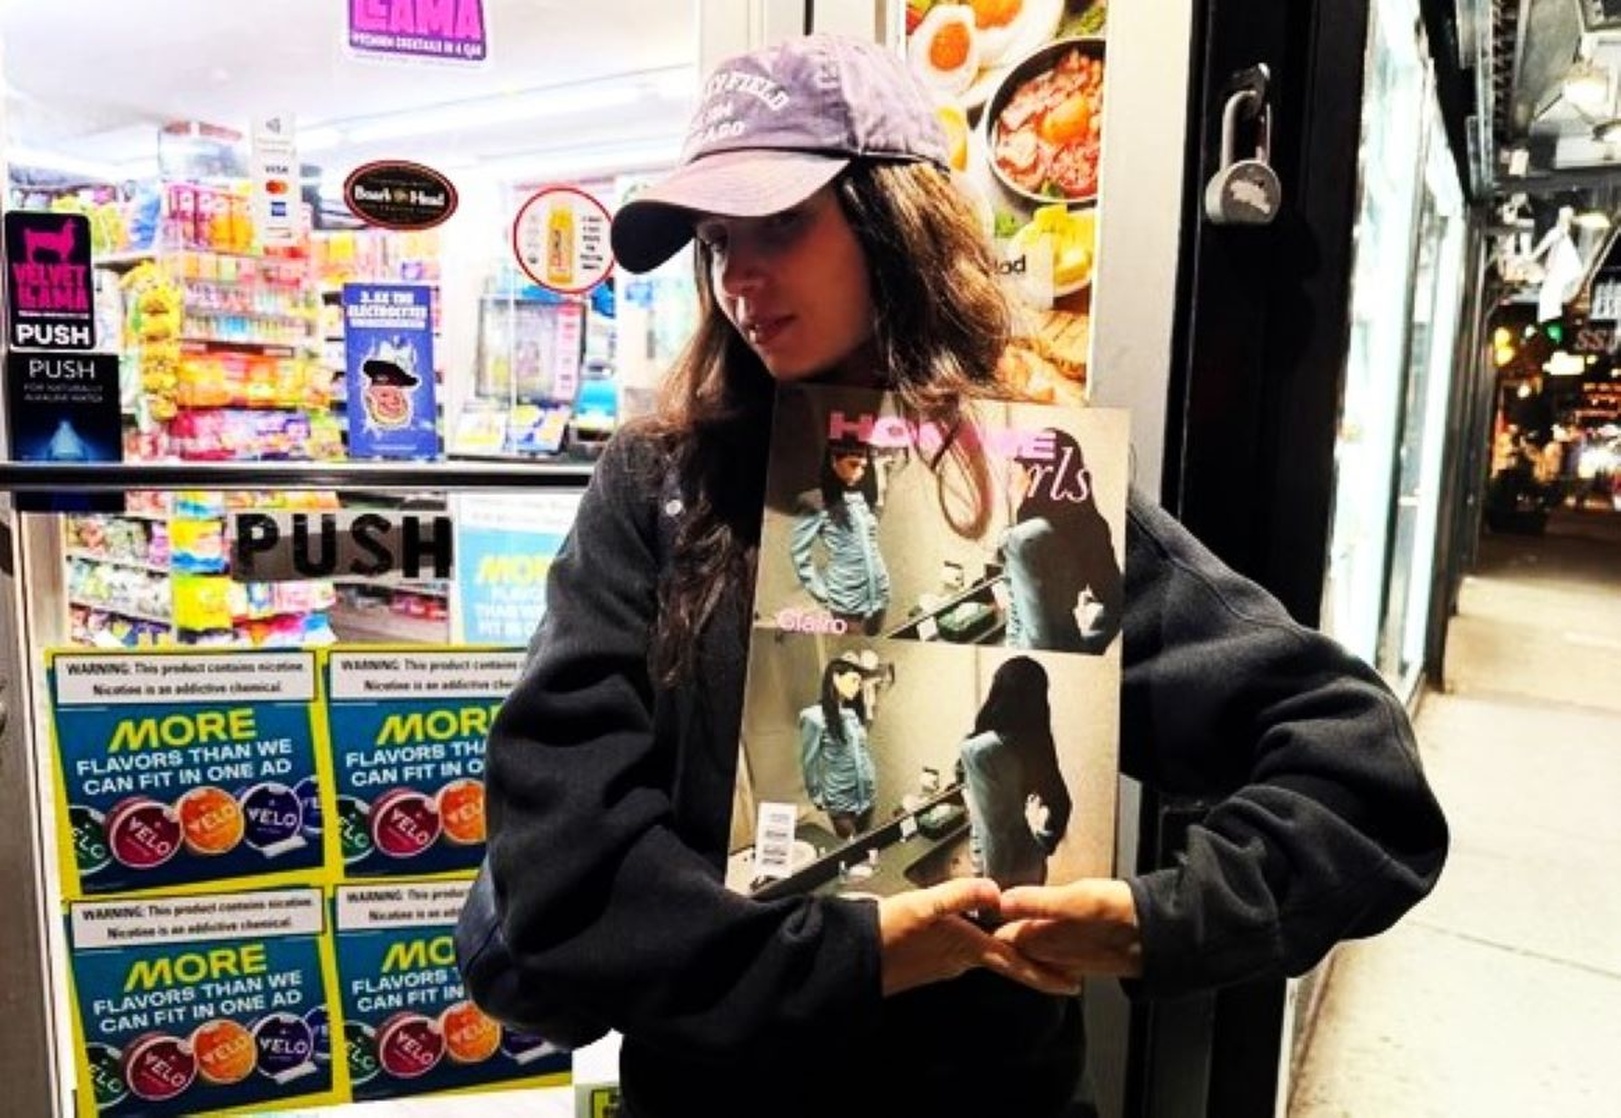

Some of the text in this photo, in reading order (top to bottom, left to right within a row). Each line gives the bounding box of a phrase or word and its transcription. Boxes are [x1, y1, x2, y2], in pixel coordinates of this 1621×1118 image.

[16, 323, 91, 346] PUSH
[29, 359, 95, 379] PUSH
[235, 513, 452, 579] PUSH
[135, 661, 158, 674] This
[162, 661, 205, 676] product
[207, 661, 255, 673] contains
[405, 657, 426, 670] This
[430, 658, 470, 673] product
[474, 659, 517, 670] contains
[93, 683, 142, 696] Nicotine
[146, 683, 156, 695] is
[158, 685, 172, 695] an
[175, 682, 226, 695] addictive
[363, 680, 410, 692] Nicotine
[413, 680, 422, 691] is
[426, 681, 440, 691] an
[441, 680, 489, 691] addictive
[108, 708, 258, 754] MORE
[76, 738, 293, 776] FLAVORS THAN WE
[346, 743, 445, 768] FLAVORS
[451, 740, 487, 756] TH
[83, 757, 293, 796] CAN FIT IN ONE AD
[352, 769, 398, 787] CAN
[404, 764, 436, 782] FIT
[441, 760, 462, 777] IN
[187, 804, 236, 832] VELO
[247, 806, 298, 828] VELO
[391, 807, 430, 845] VELO
[129, 816, 172, 857] VELO
[408, 888, 428, 900] This
[433, 888, 464, 901] produ
[148, 904, 172, 917] This
[174, 902, 217, 918] product
[218, 900, 266, 912] contains
[369, 909, 412, 922] Nicotine
[416, 910, 425, 919] is
[428, 910, 440, 918] an
[107, 925, 156, 940] Nicotine
[158, 926, 168, 936] is
[171, 926, 185, 936] an
[188, 921, 237, 935] addictive
[123, 943, 268, 993] MORE
[381, 935, 456, 974] MO
[93, 969, 303, 1015] FLAVORS THAN WE
[352, 967, 448, 995] FLAVORS
[99, 989, 303, 1033] CAN FIT IN ONE AD
[357, 984, 465, 1013] CAN FIT IN
[260, 1037, 308, 1055] VELO
[396, 1030, 434, 1065] VELO
[145, 1051, 187, 1087] VELO
